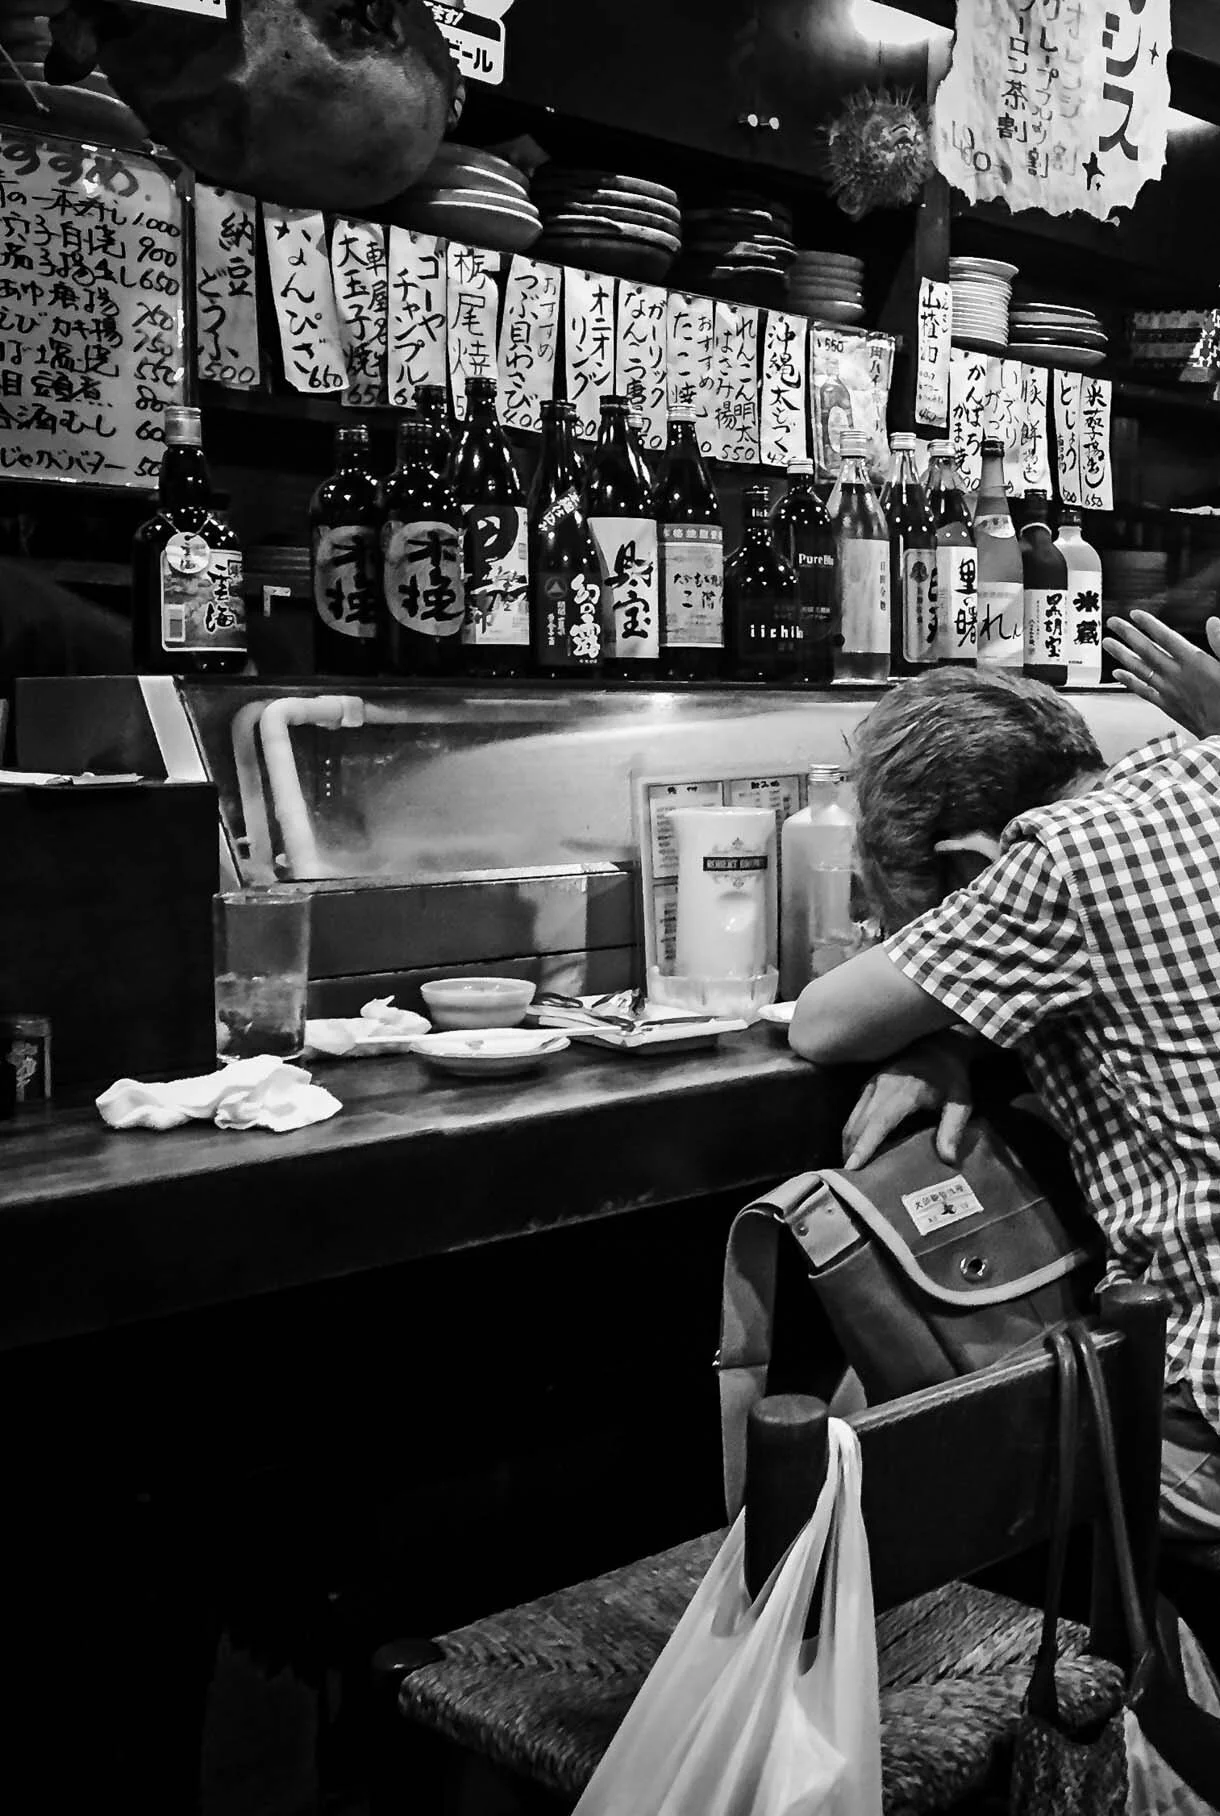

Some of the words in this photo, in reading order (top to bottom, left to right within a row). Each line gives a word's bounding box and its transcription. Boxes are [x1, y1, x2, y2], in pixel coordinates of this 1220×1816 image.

[137, 237, 178, 267] 900
[139, 269, 180, 296] 650
[590, 284, 611, 387] オニオン
[571, 317, 595, 400] リング
[203, 362, 255, 384] 500
[308, 365, 343, 388] 650
[721, 444, 755, 461] 550
